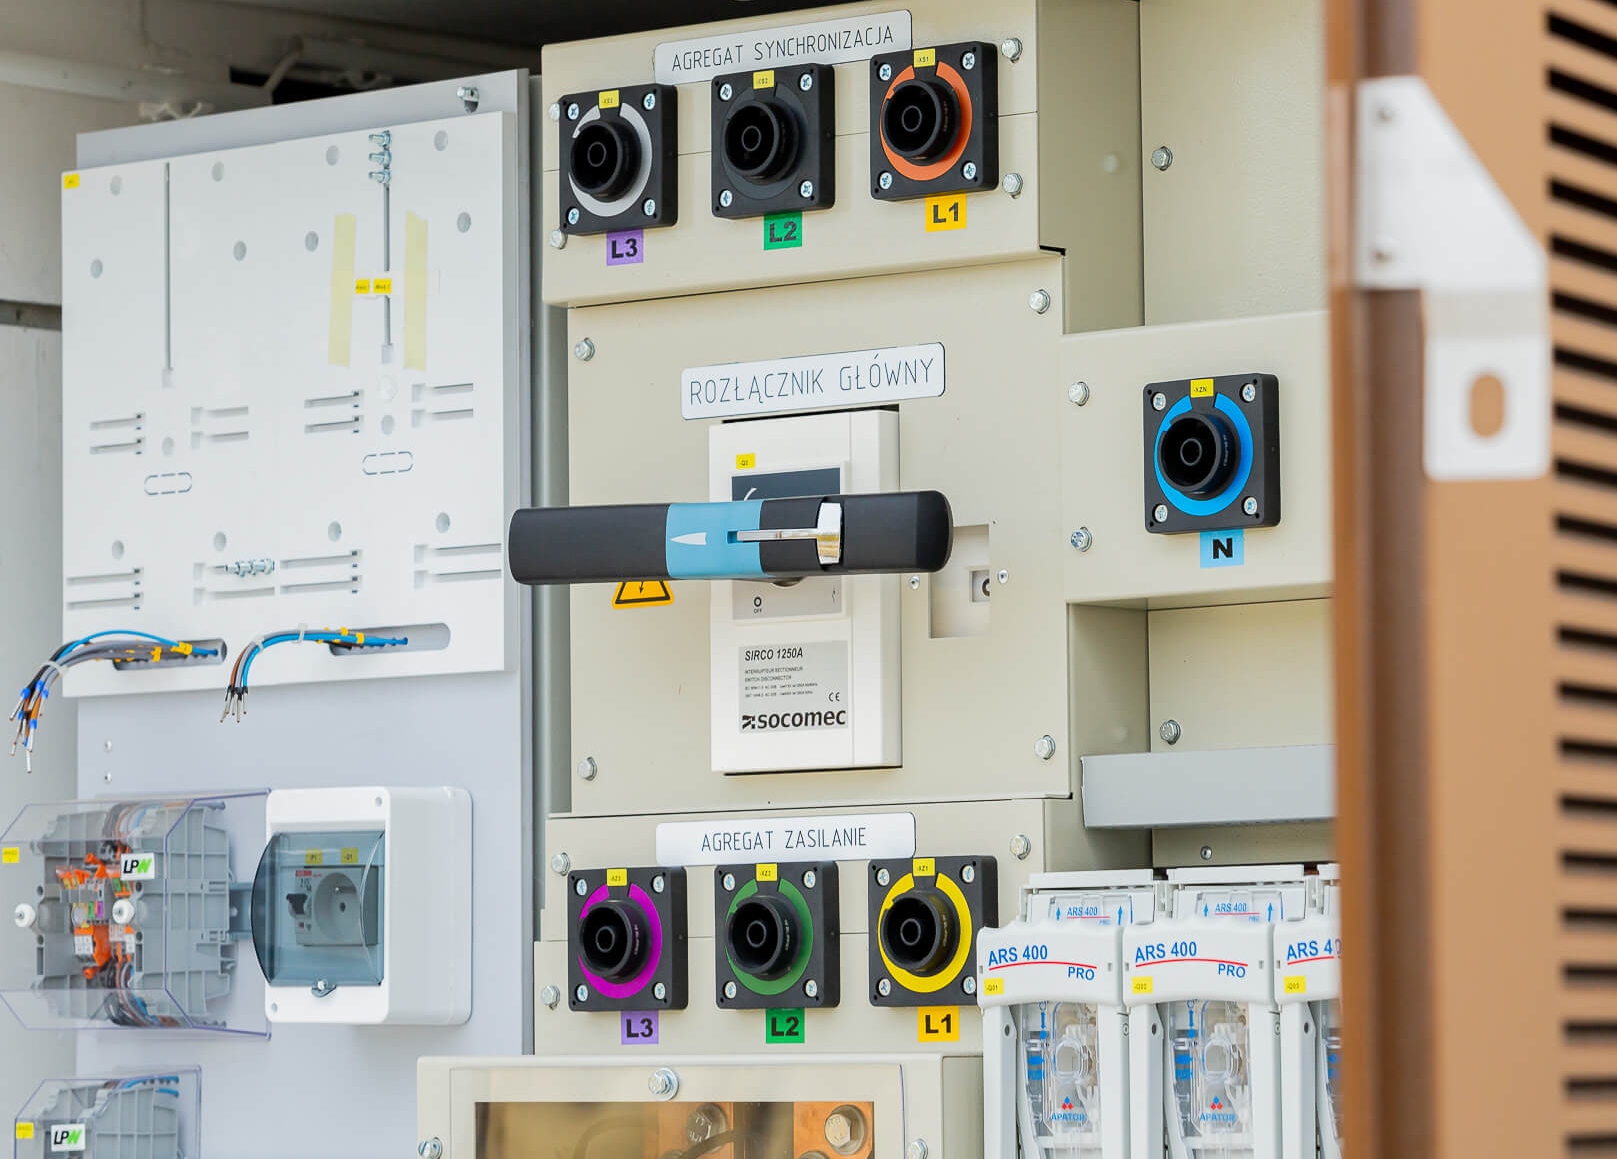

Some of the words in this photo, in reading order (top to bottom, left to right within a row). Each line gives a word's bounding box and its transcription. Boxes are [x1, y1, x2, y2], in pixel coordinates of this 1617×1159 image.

[671, 44, 744, 72] AGREGAT
[754, 25, 894, 61] SYNCHRONIZACJA
[932, 202, 959, 224] L1
[769, 221, 797, 243] L2
[611, 238, 638, 259] L3
[690, 368, 824, 405] ROZŁĄCZNIK
[839, 353, 933, 391] GŁÓWNY
[1212, 537, 1233, 560] N
[745, 649, 774, 661] SIRCO
[776, 647, 804, 660] 1250A
[757, 709, 847, 729] socomec
[701, 830, 774, 852] AGREGAT
[784, 827, 867, 849] ZASILANIE
[1066, 906, 1083, 916] ARS
[1084, 906, 1098, 916] 400
[1215, 903, 1232, 912] ARS
[1233, 902, 1247, 912] 400
[988, 946, 1018, 967] ARS
[1022, 944, 1048, 960] 400
[1135, 943, 1166, 963] ARS
[1170, 941, 1197, 957] 400
[1286, 940, 1319, 960] ARS
[1323, 938, 1343, 955] 40
[1067, 966, 1095, 981] PRO
[1218, 963, 1246, 978] PRO
[626, 1018, 654, 1038] L3
[771, 1016, 799, 1037] L2
[925, 1013, 952, 1034] L1
